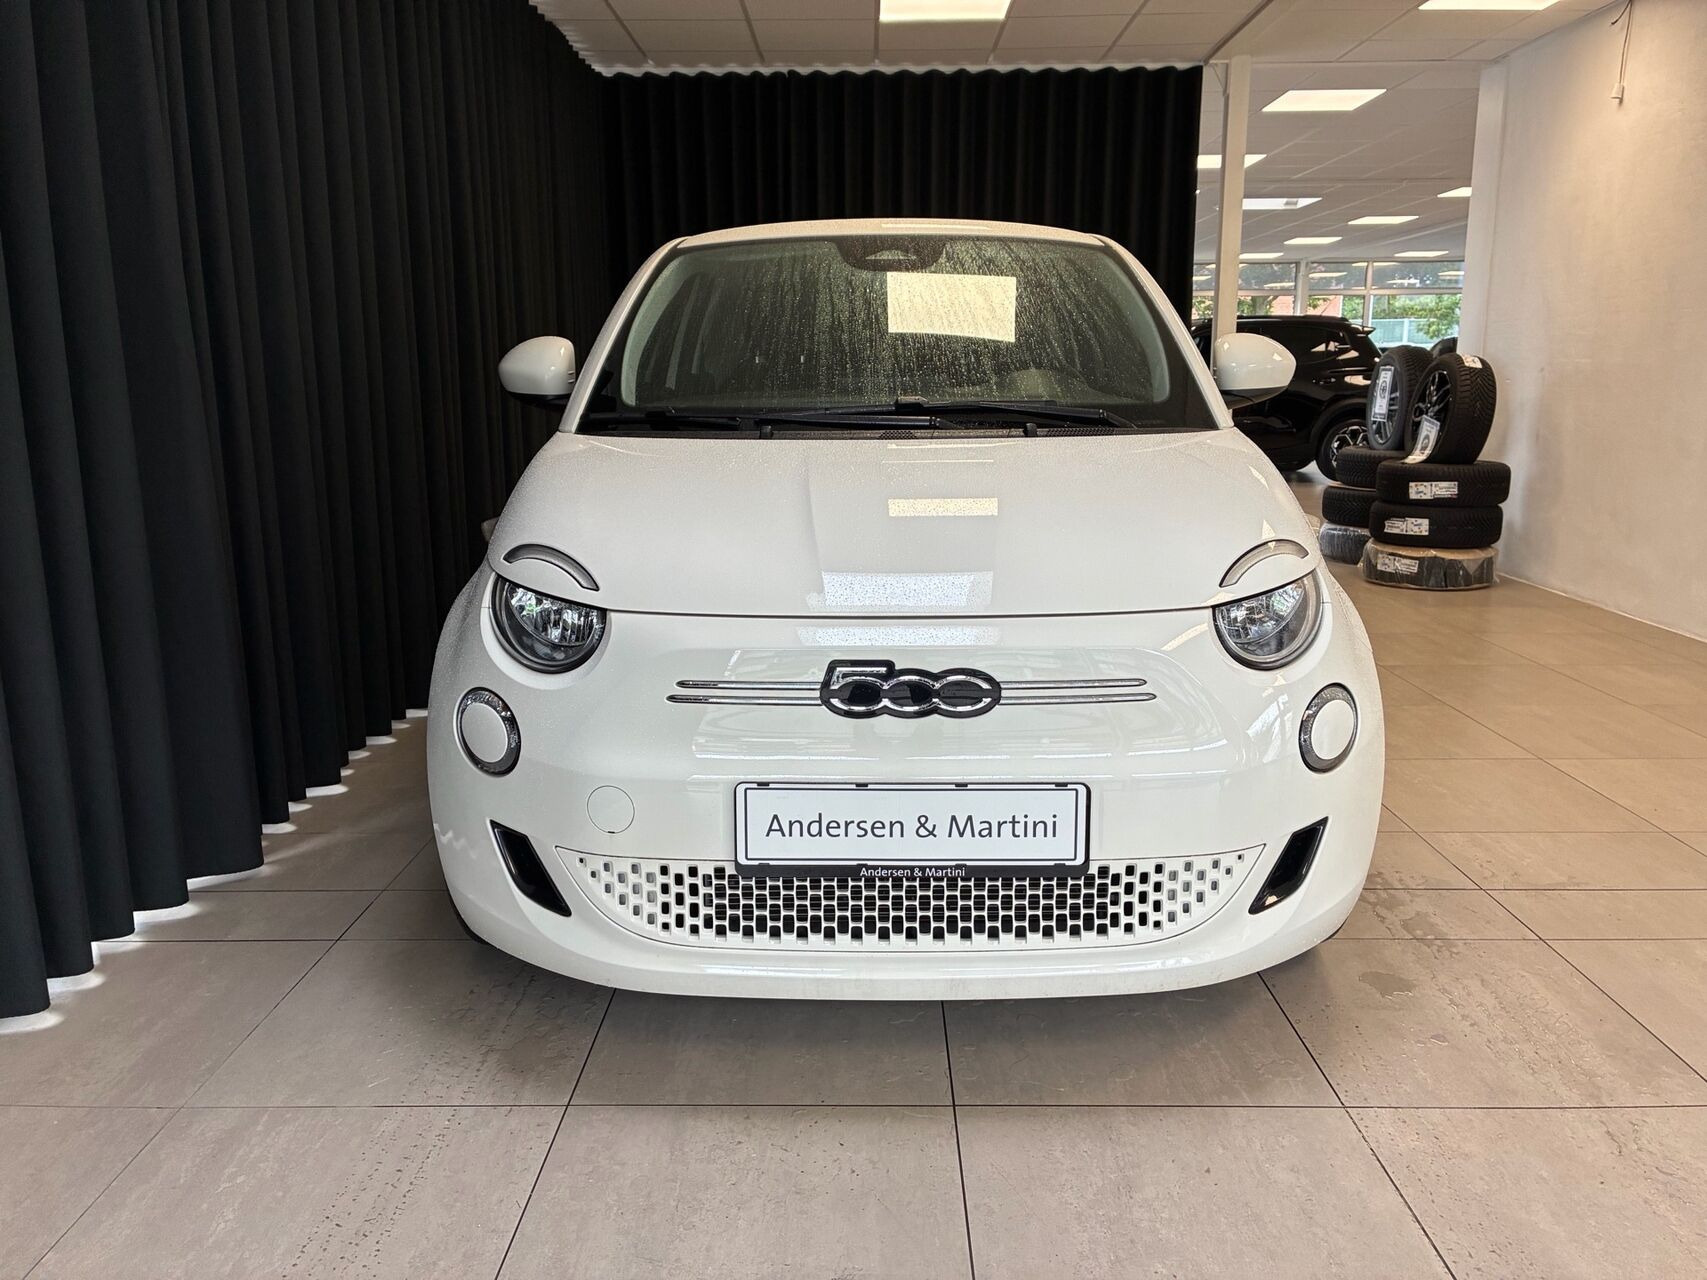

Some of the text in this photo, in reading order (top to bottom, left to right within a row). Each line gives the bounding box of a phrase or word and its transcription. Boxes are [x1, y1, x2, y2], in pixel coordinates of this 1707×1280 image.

[827, 665, 994, 713] 500
[765, 812, 1058, 839] Andersen & Martini
[859, 867, 966, 878] Andersen & Martini
